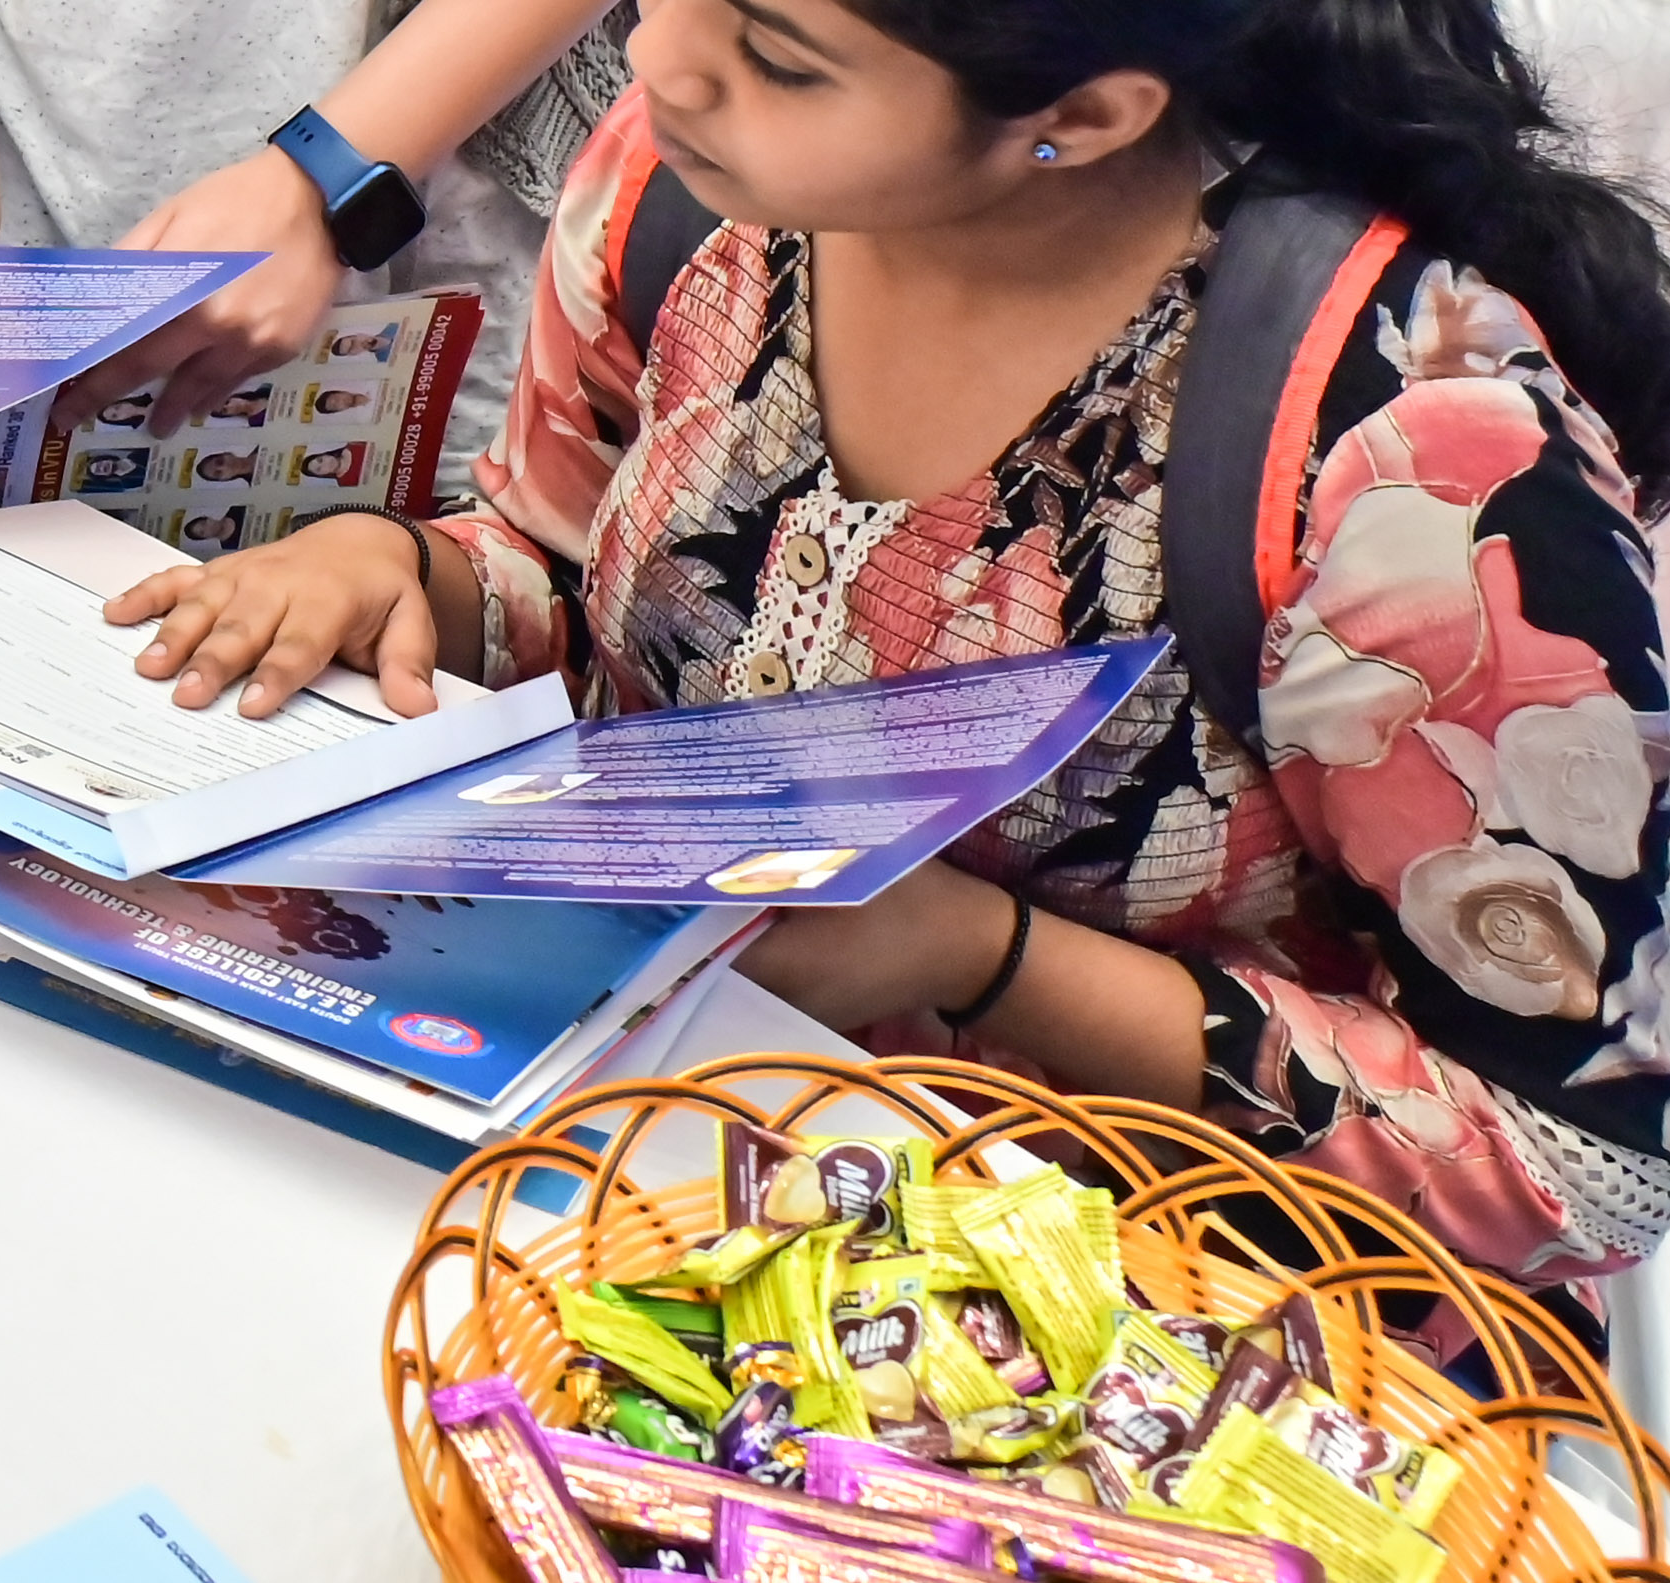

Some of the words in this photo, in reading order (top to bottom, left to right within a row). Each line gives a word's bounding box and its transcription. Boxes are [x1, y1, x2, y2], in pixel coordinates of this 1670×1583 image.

[42, 439, 65, 469] VTU
[6, 855, 168, 931] TECHNOLOGY
[131, 925, 167, 950] OF
[170, 937, 283, 993] COLLEGE
[197, 933, 379, 1006] ENGINEERING
[291, 982, 365, 1018] S.E.A.
